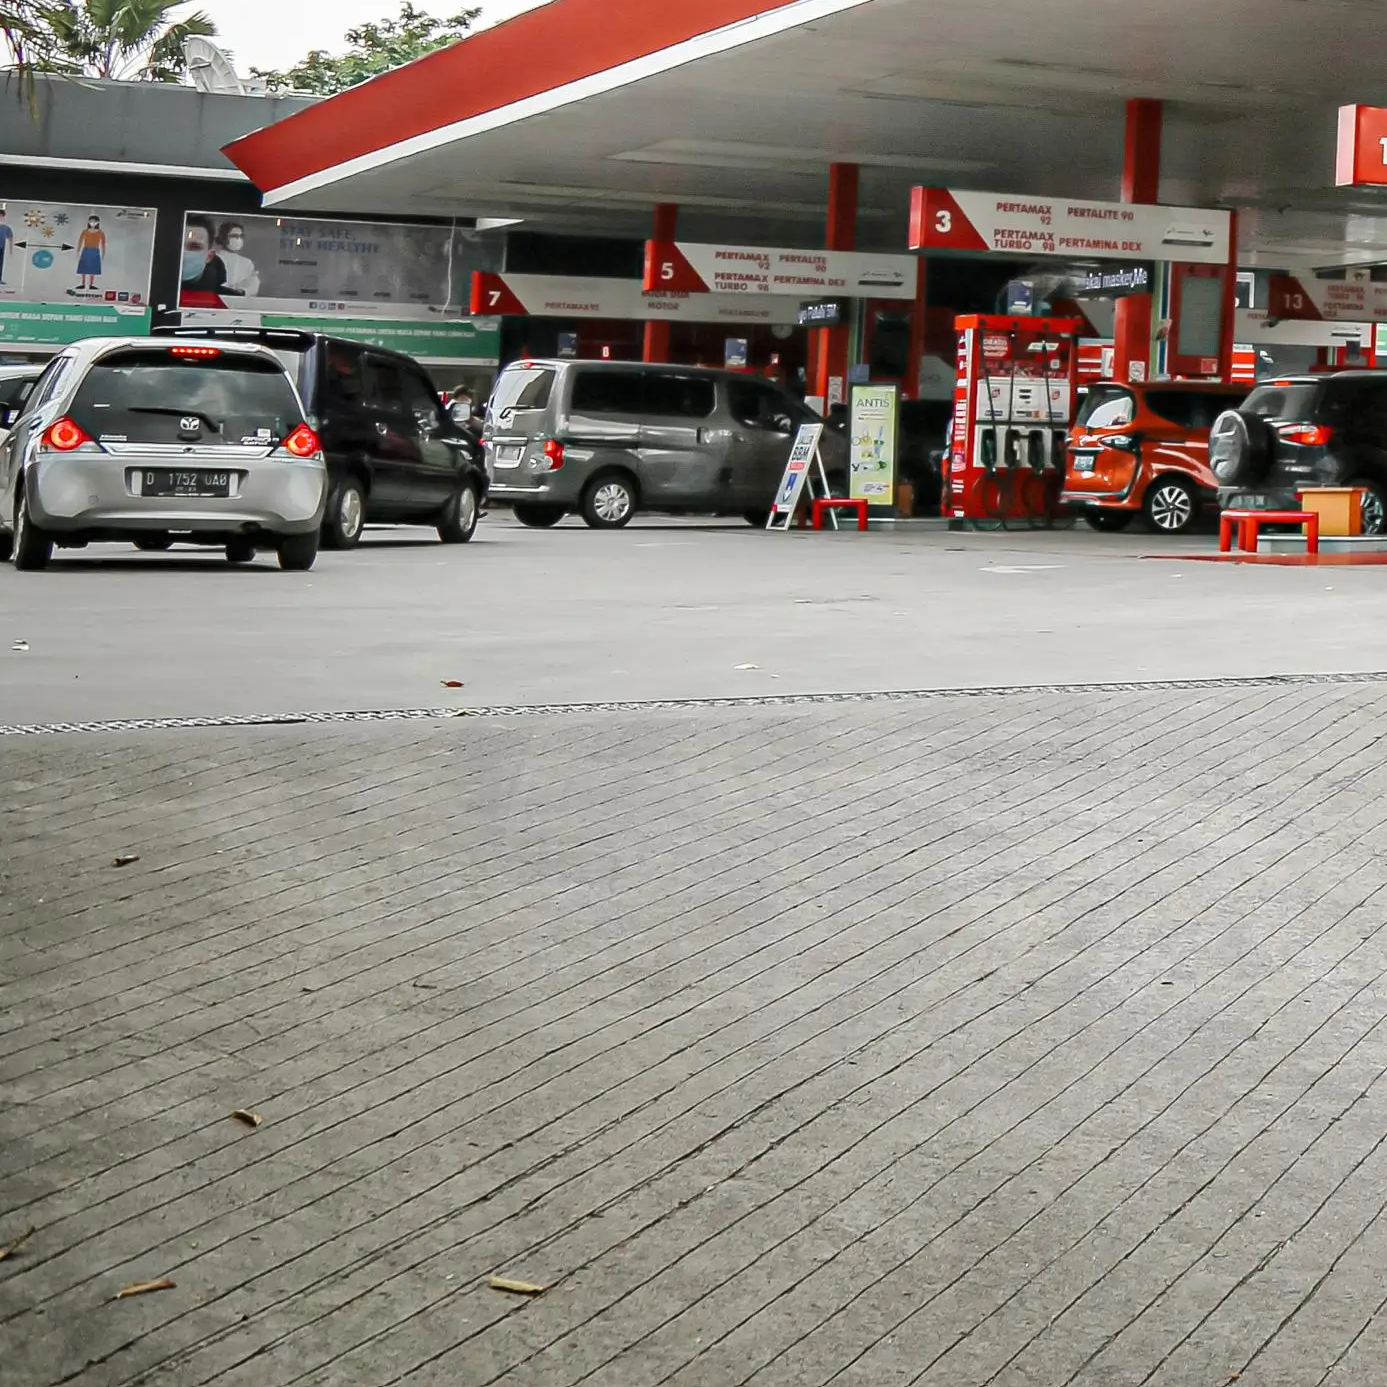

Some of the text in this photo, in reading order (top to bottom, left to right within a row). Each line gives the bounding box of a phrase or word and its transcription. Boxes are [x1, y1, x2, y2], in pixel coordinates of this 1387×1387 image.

[996, 201, 1053, 215] PERTAMAX
[1067, 206, 1119, 221] PERTALITE
[935, 210, 951, 233] 3
[994, 228, 1055, 242] PERTAMAX
[994, 239, 1032, 251] TURBO
[1059, 237, 1142, 251] PERTAMINA DEX
[715, 250, 770, 262] PERTAMAX
[661, 262, 674, 280] 5
[714, 271, 768, 283] PERTAMAX
[714, 281, 748, 292] TURBO
[489, 291, 502, 306] 7
[1284, 294, 1303, 309] 13
[856, 397, 890, 408] ANTIS
[147, 472, 154, 485] D
[169, 473, 197, 485] 1752
